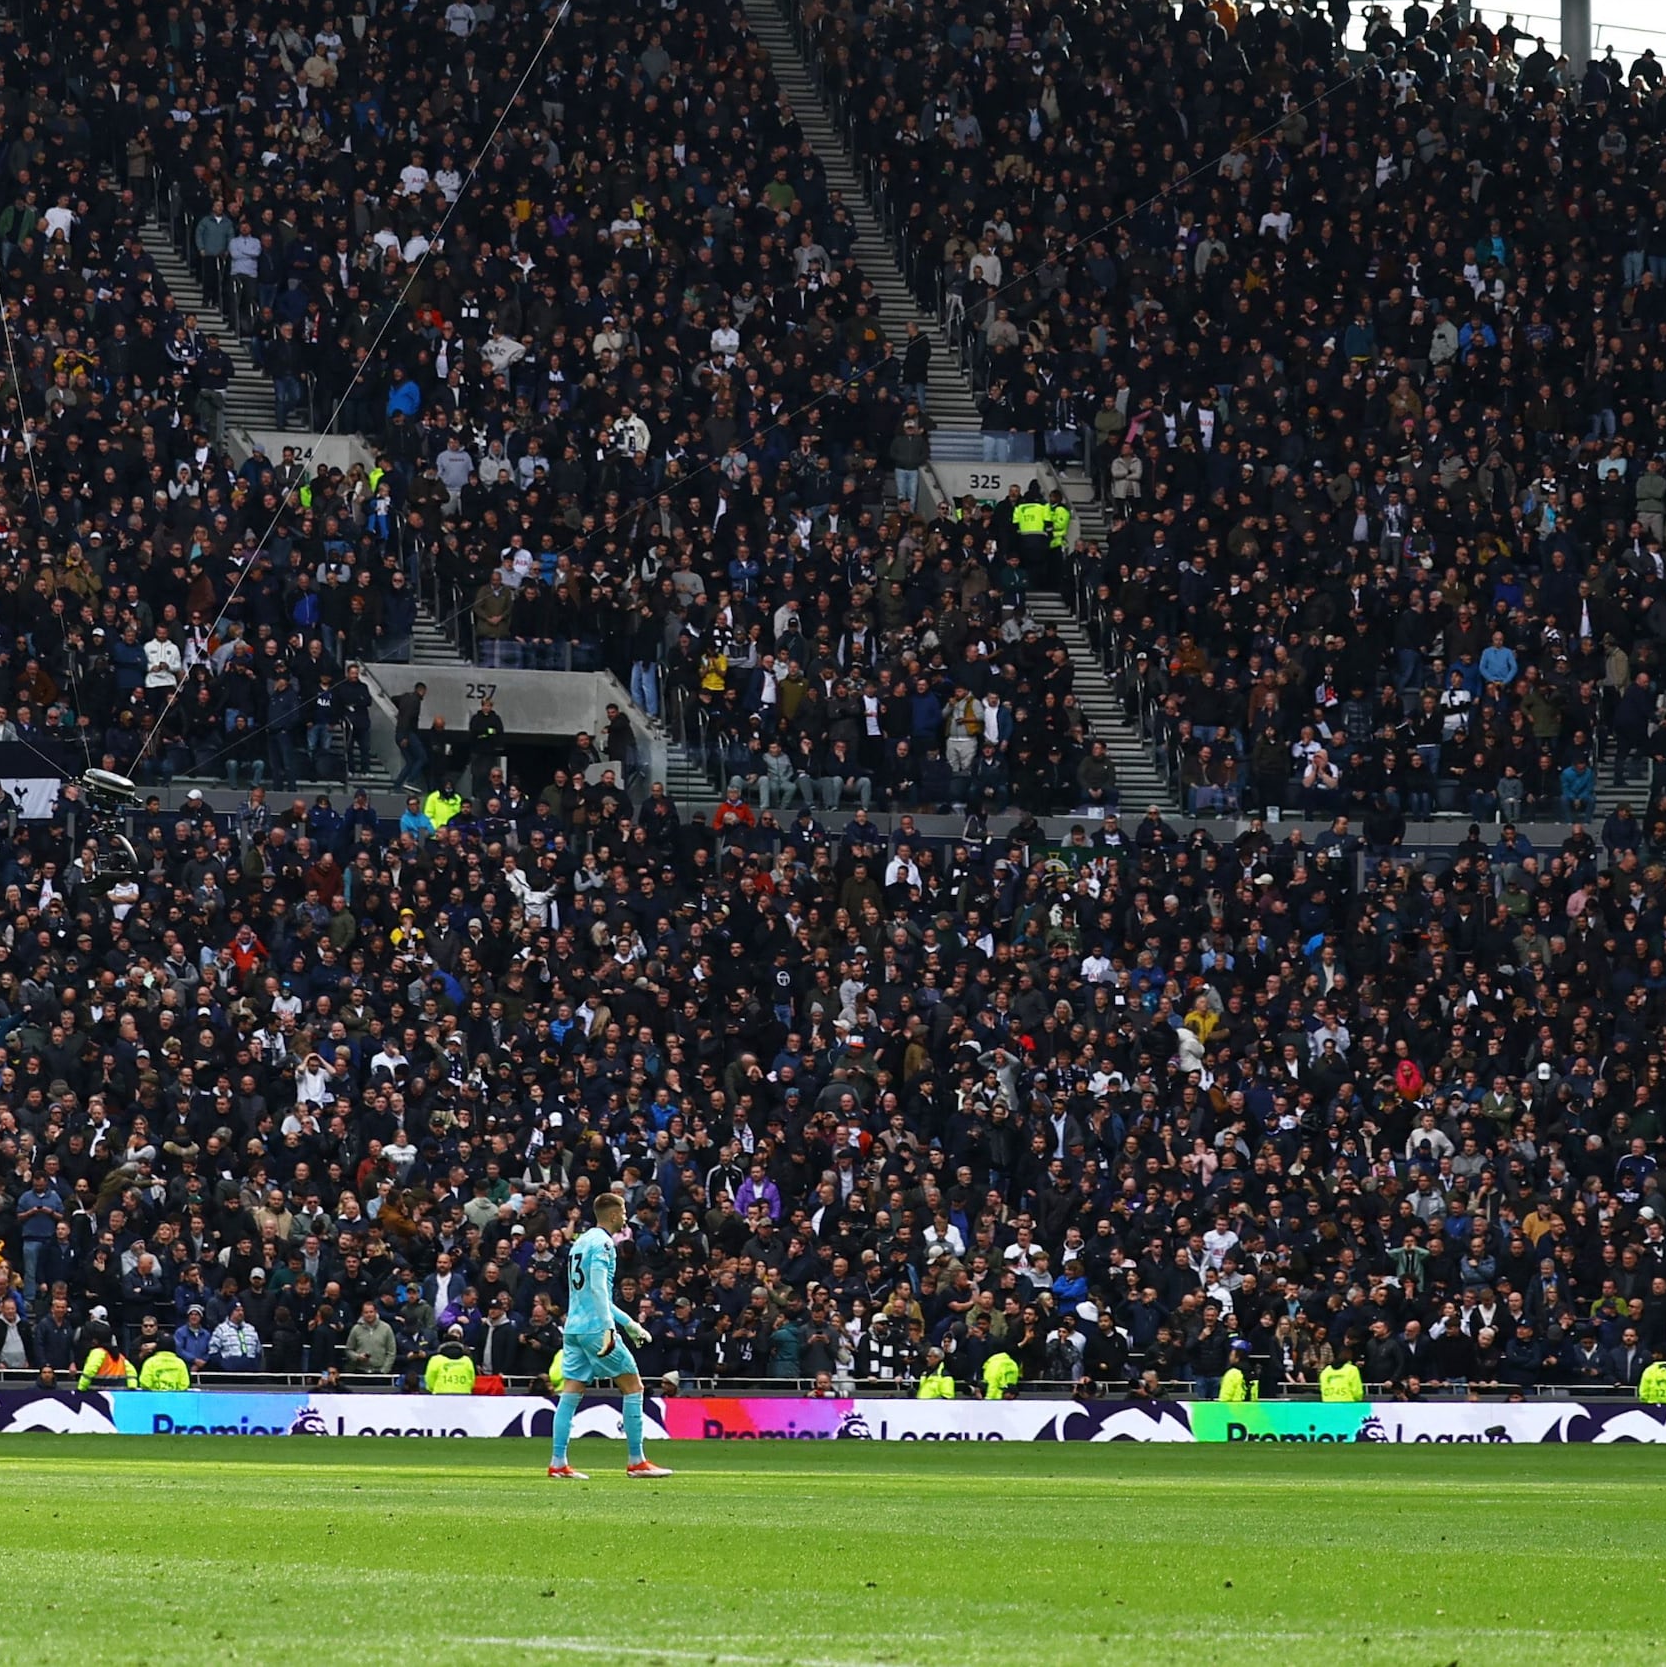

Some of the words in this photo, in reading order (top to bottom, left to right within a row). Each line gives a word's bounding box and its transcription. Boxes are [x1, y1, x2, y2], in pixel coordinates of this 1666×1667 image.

[293, 446, 314, 462] 24
[970, 474, 1001, 490] 325
[465, 683, 497, 700] 257
[568, 1252, 585, 1291] 13
